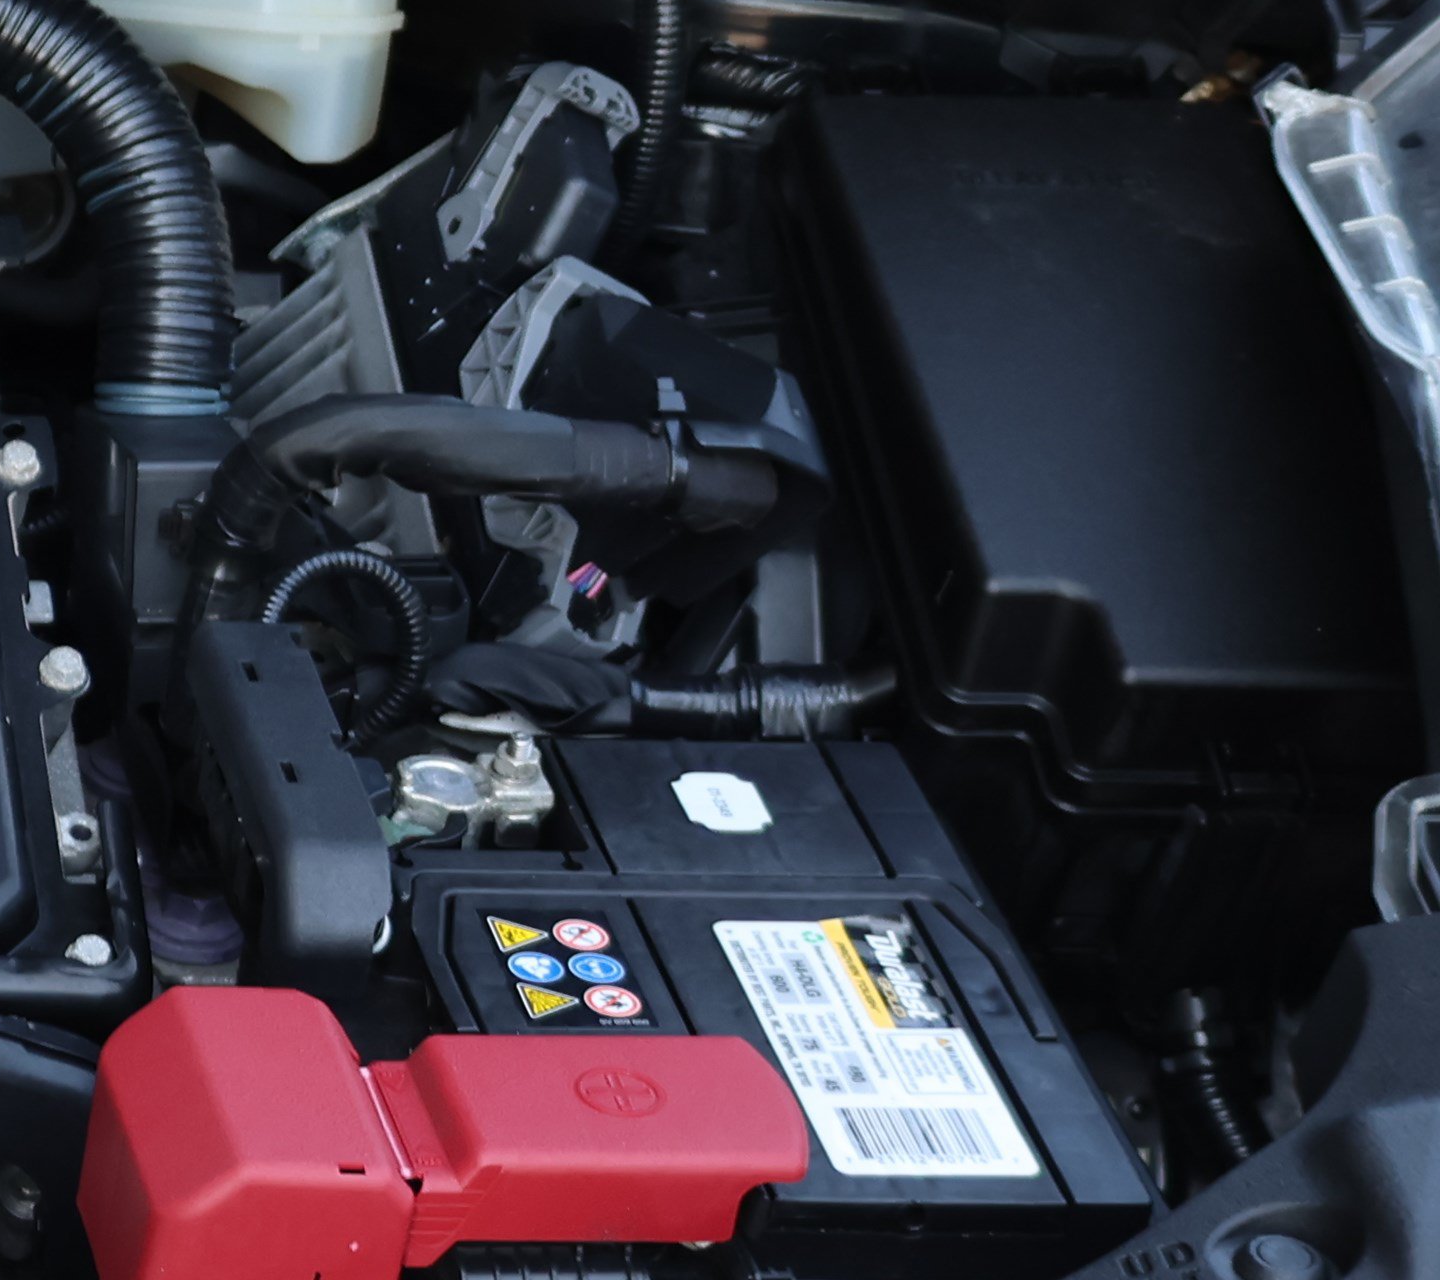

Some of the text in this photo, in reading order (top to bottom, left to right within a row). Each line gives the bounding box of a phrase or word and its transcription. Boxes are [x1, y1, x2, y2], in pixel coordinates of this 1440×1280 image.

[789, 959, 821, 999] H4-DLG
[864, 929, 941, 1022] Duralast
[876, 976, 908, 1019] GOLD
